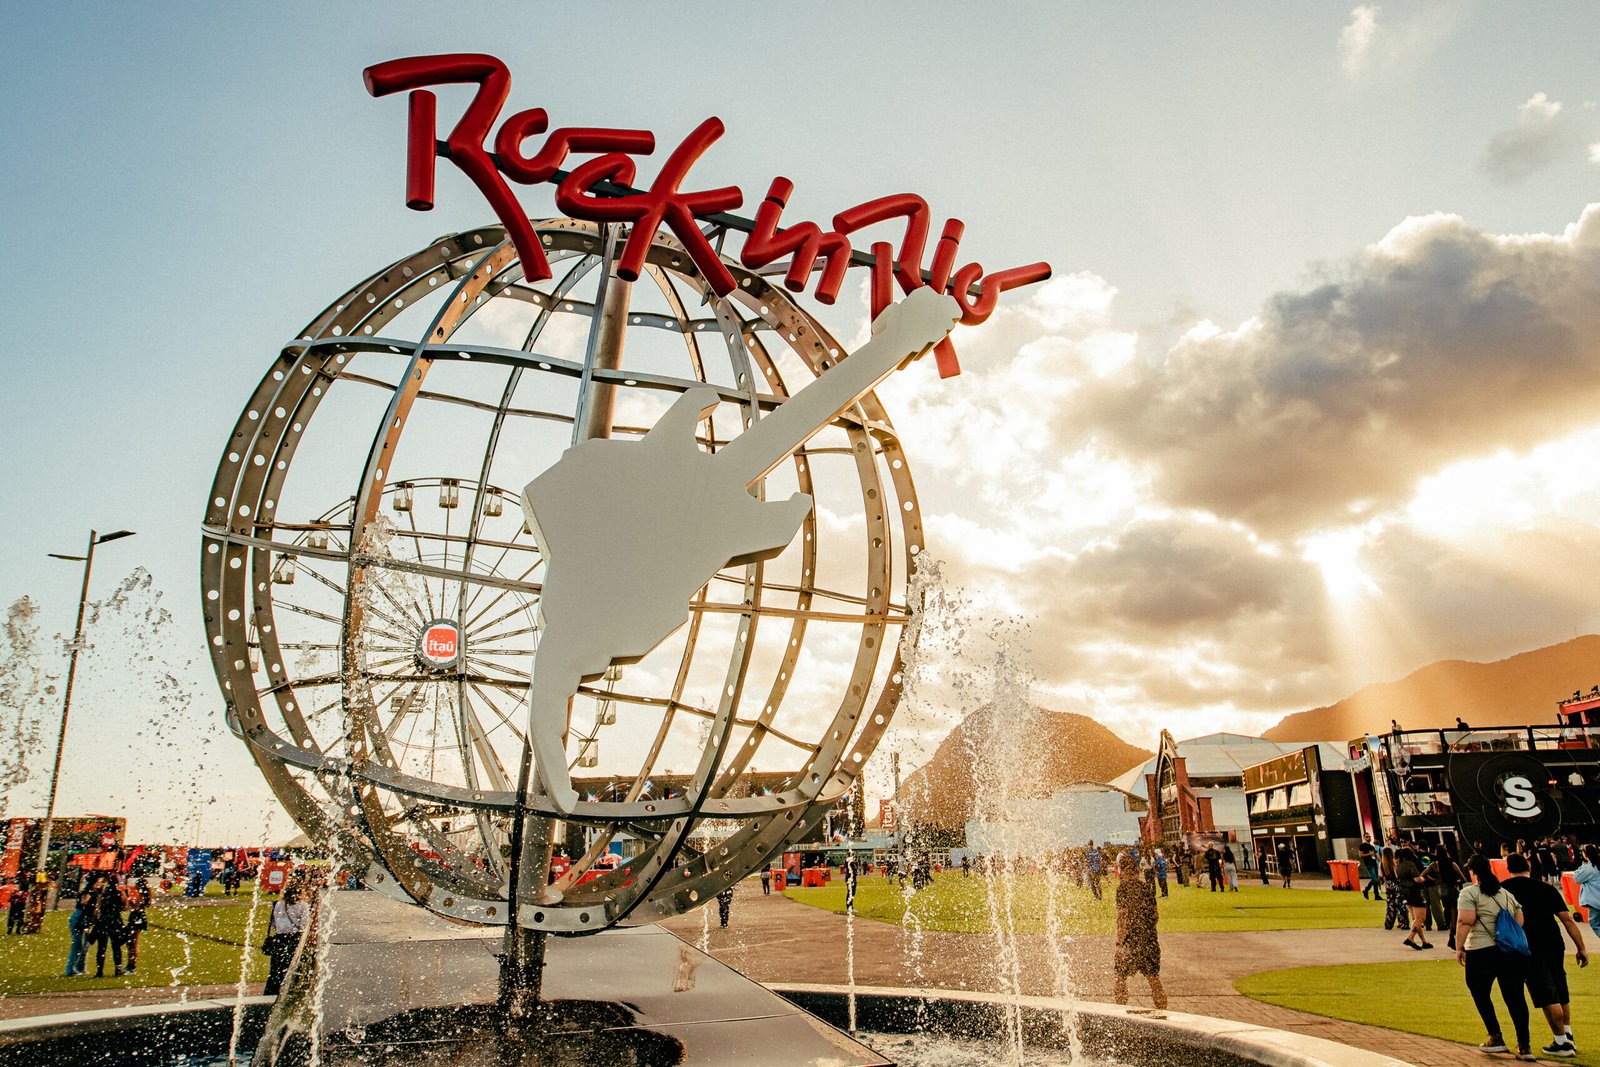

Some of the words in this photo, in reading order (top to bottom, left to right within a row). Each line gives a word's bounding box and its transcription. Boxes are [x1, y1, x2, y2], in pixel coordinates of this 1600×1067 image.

[363, 53, 743, 298] Rock
[741, 176, 852, 305] in
[832, 193, 1052, 379] Rio
[1503, 776, 1536, 809] S
